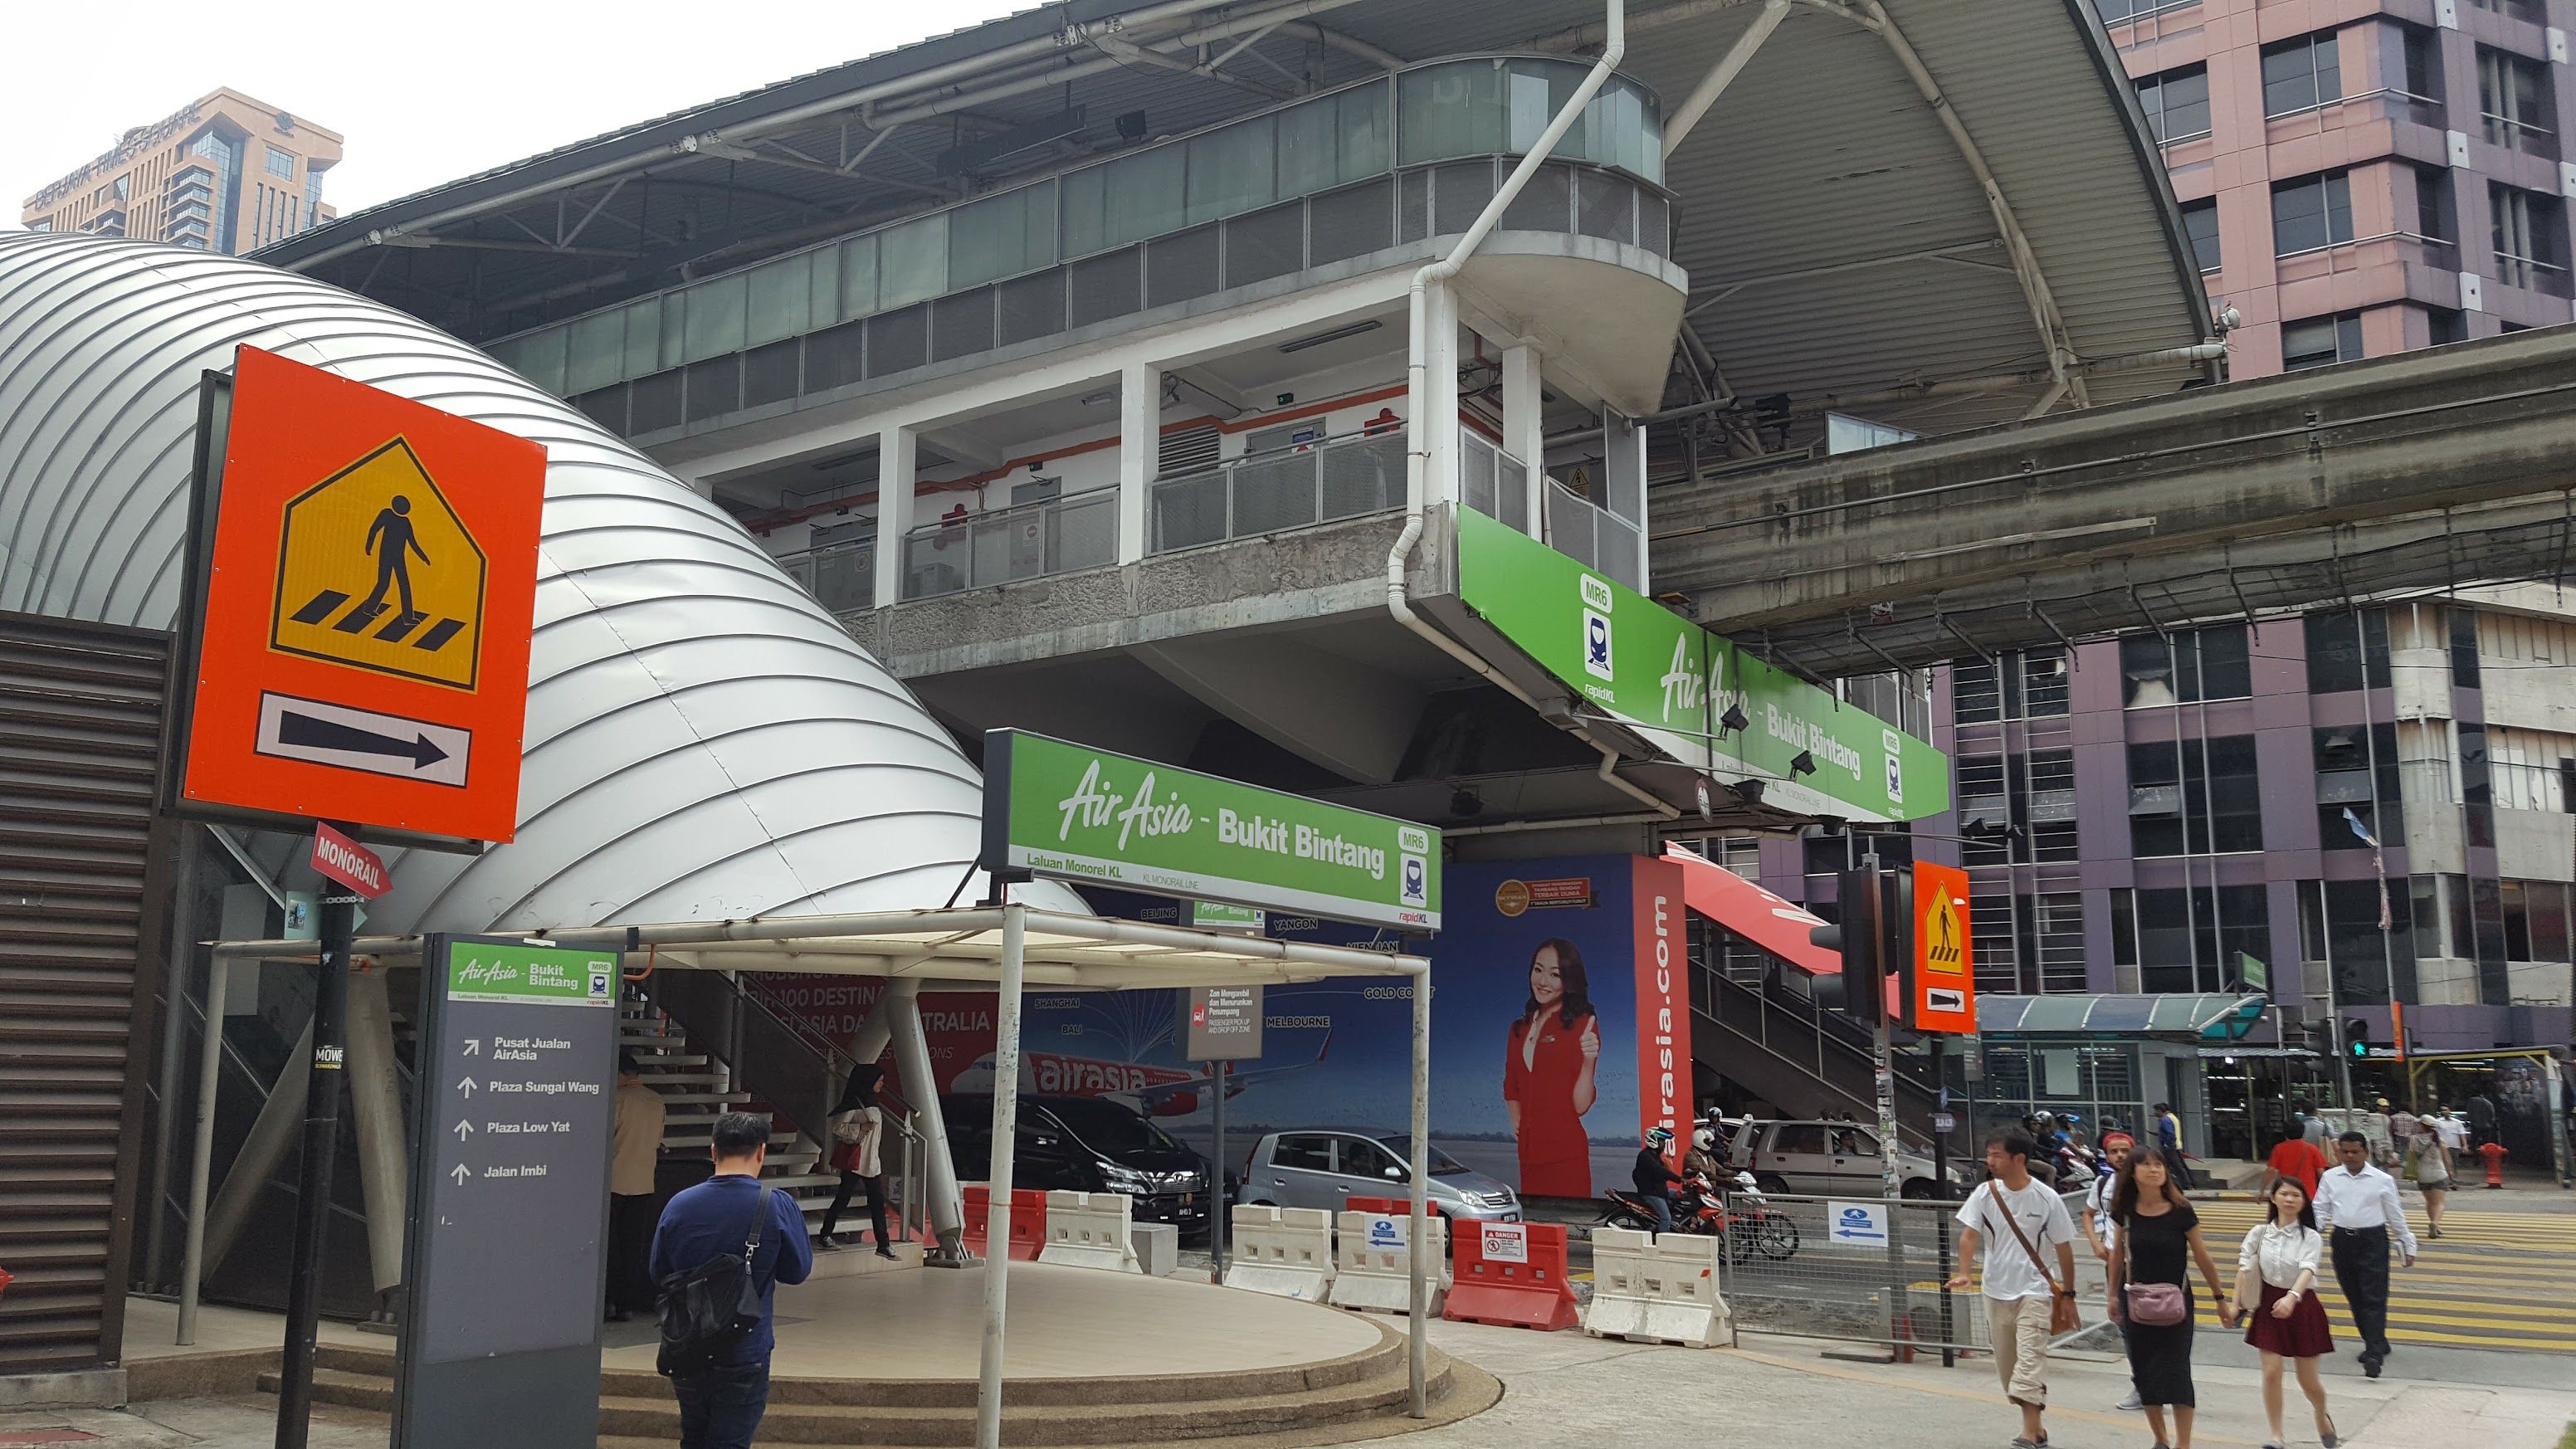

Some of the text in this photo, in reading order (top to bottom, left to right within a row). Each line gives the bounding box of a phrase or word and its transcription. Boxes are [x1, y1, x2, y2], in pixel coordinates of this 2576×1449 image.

[1586, 582, 1608, 606] MR6
[1585, 684, 1615, 704] rapidKL
[1767, 703, 1808, 750] Bukit
[1809, 724, 1861, 781] Bintang
[1218, 807, 1288, 854] Bukit
[1295, 824, 1384, 881] Bintang
[1403, 832, 1424, 850] MR6
[318, 837, 379, 890] MONORAIL
[1027, 853, 1122, 878] Laluan Monorel KL
[1143, 873, 1199, 890] KL MONORAIL LINE
[1141, 907, 1177, 920] BEIJING
[1399, 911, 1427, 924] rapidKL
[1274, 918, 1319, 931] YANGON
[529, 964, 564, 976] Bukit
[529, 975, 578, 990] Bintang
[1209, 989, 1221, 998] Zon
[1364, 988, 1394, 999] GOLD
[1035, 998, 1081, 1009] SHANGHAI
[1209, 998, 1220, 1007] dan
[1208, 1007, 1240, 1017] Penumpang
[1266, 1016, 1330, 1028] MELBOURNE
[1062, 1024, 1082, 1035] BALI
[494, 1037, 571, 1049] Pusat Jualan
[493, 1050, 538, 1061] AirAsia
[1040, 1056, 1147, 1092] airasia
[489, 1081, 600, 1095] Plaza Sungai Wang
[486, 1122, 570, 1134] Plaza Low Yat
[483, 1165, 547, 1178] Jalan Imbi
